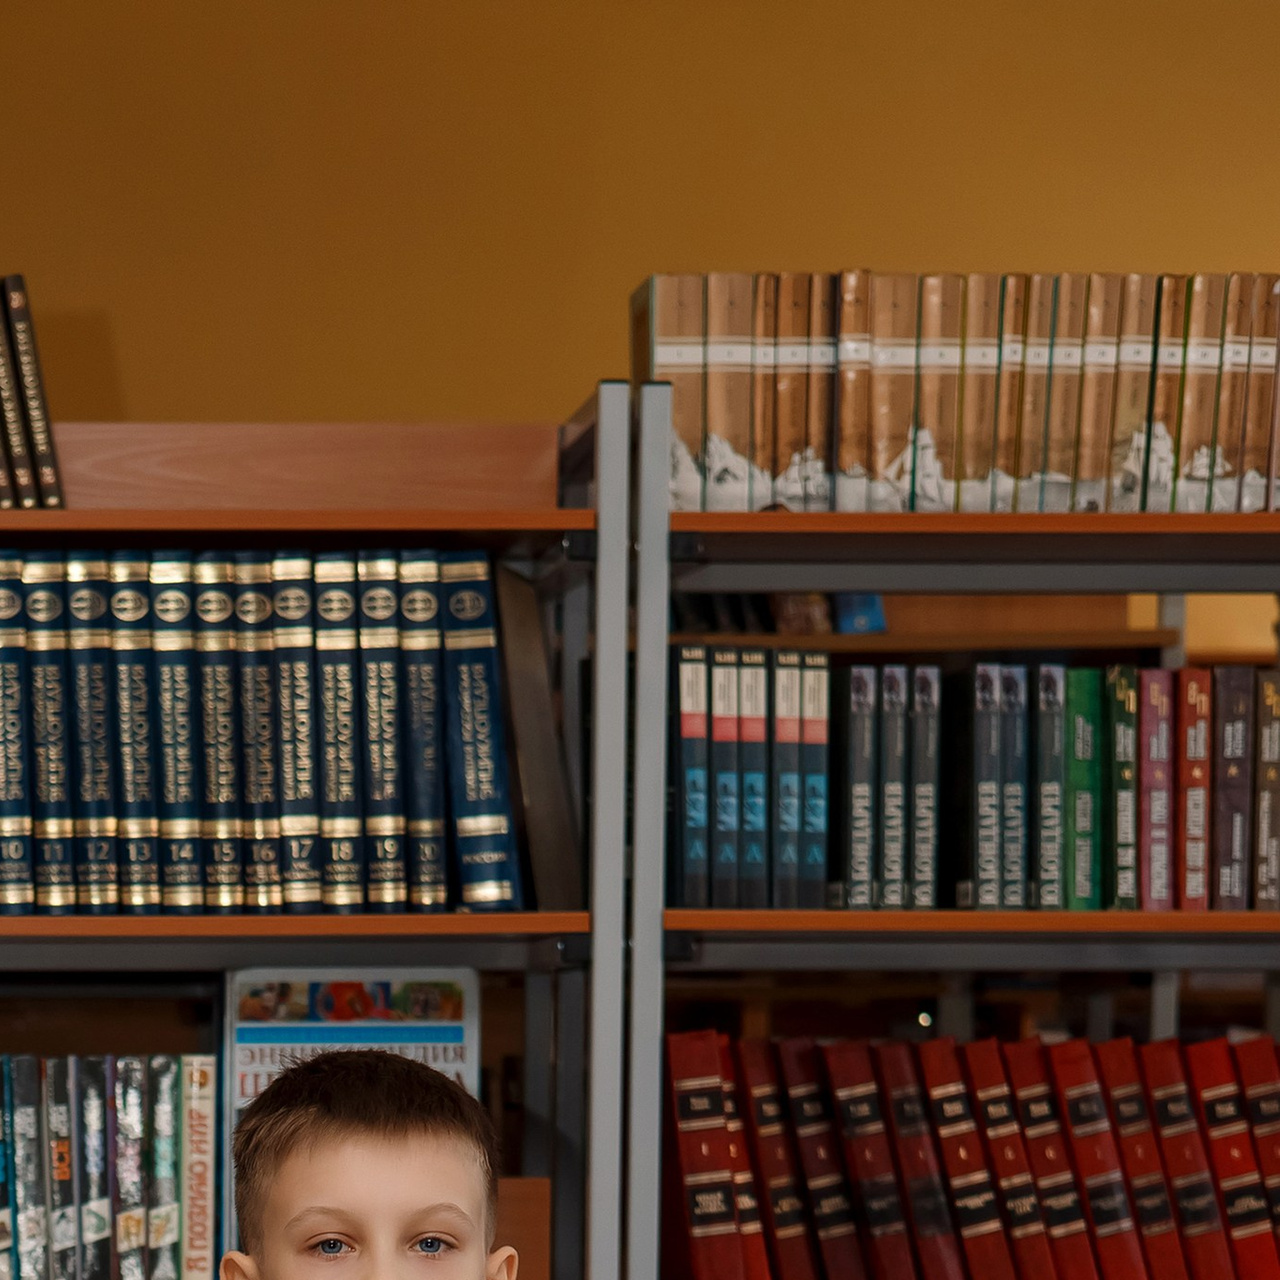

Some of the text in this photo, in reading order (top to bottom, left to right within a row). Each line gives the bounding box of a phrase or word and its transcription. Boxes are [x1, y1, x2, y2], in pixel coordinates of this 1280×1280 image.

[0, 841, 24, 860] 10
[43, 842, 63, 861] 11
[87, 842, 110, 860] 12
[129, 842, 151, 861] 13
[171, 842, 193, 861] 14
[213, 843, 235, 861] 15
[252, 843, 276, 862] 16
[290, 839, 313, 858] 17
[331, 841, 353, 861] 18
[376, 839, 399, 858] 19
[186, 1108, 208, 1272] Я ПОЗНАЮ МИР
